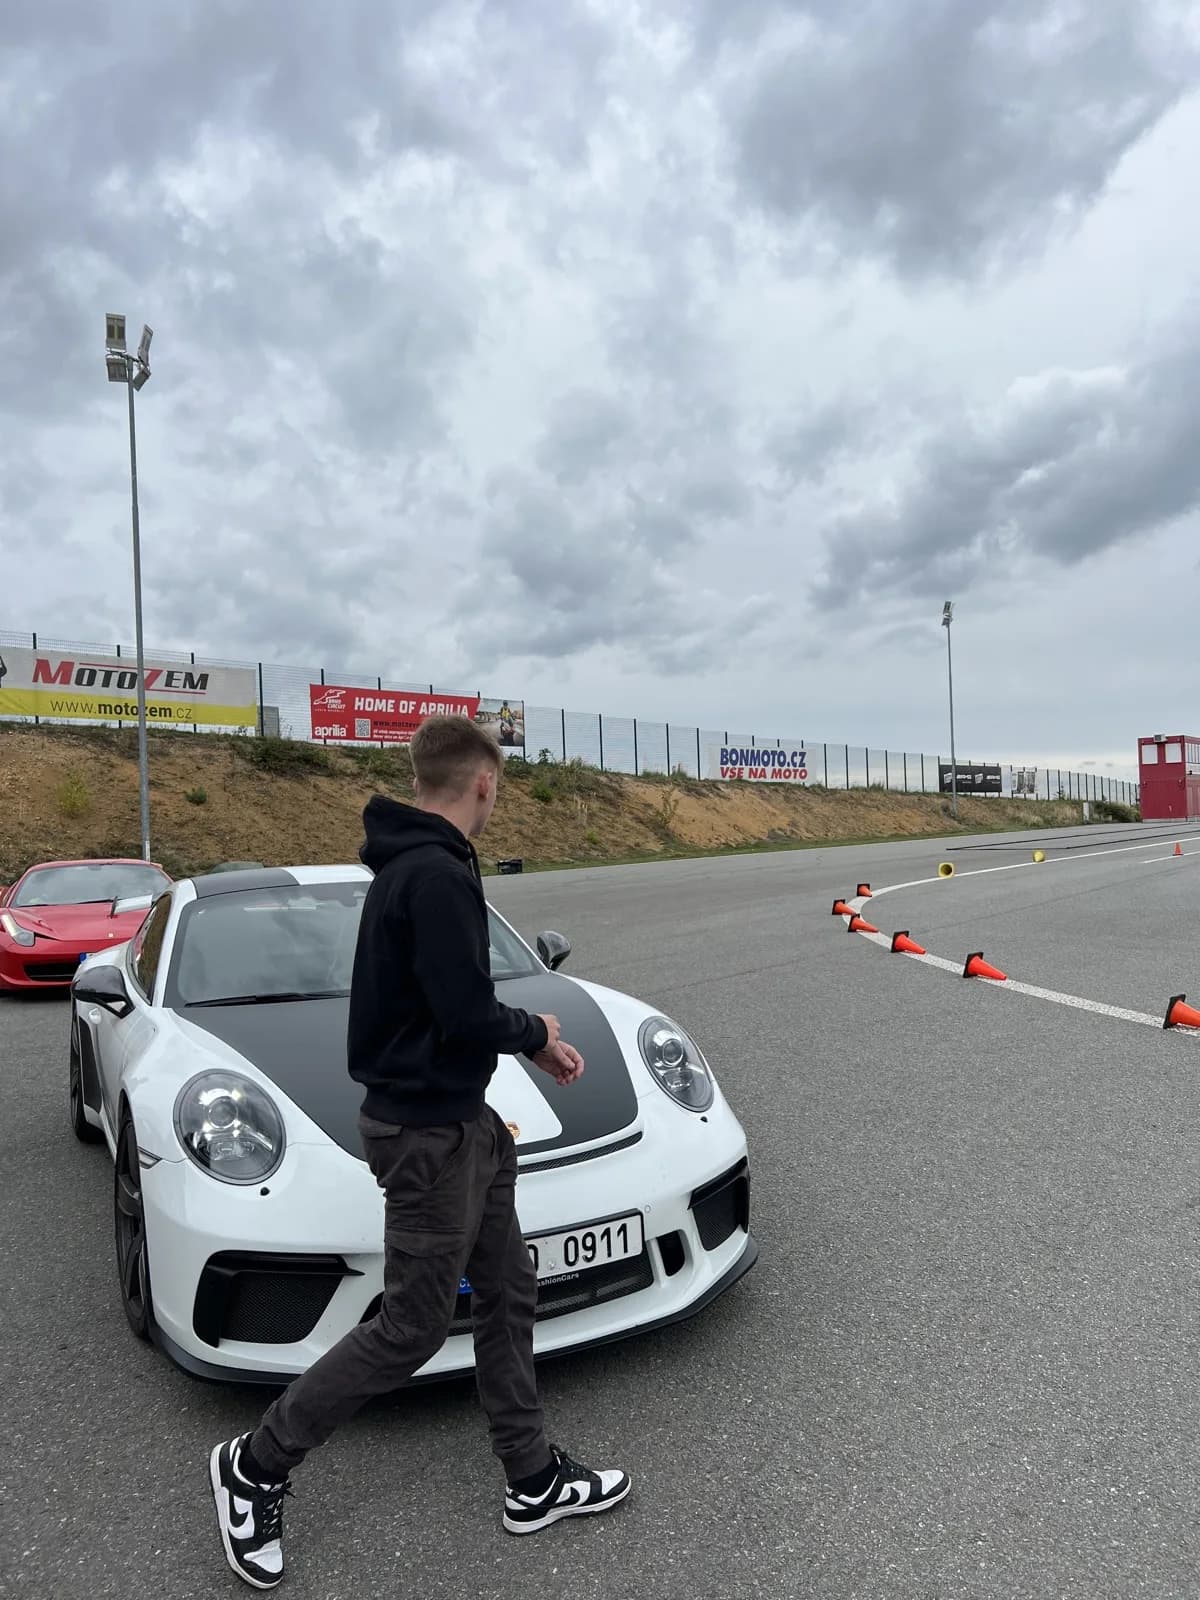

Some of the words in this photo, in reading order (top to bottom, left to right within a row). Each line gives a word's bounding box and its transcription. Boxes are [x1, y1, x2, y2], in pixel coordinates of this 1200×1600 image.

[354, 697, 395, 712] HOME
[399, 700, 417, 714] OF
[419, 702, 469, 718] APRILIA
[314, 724, 347, 738] aprilia
[720, 748, 807, 768] BONMOTO.CZ
[720, 767, 744, 778] VSE
[748, 768, 767, 778] NA
[771, 768, 808, 780] MOTO
[564, 1223, 629, 1267] 0911
[537, 1273, 580, 1287] ashionCars
